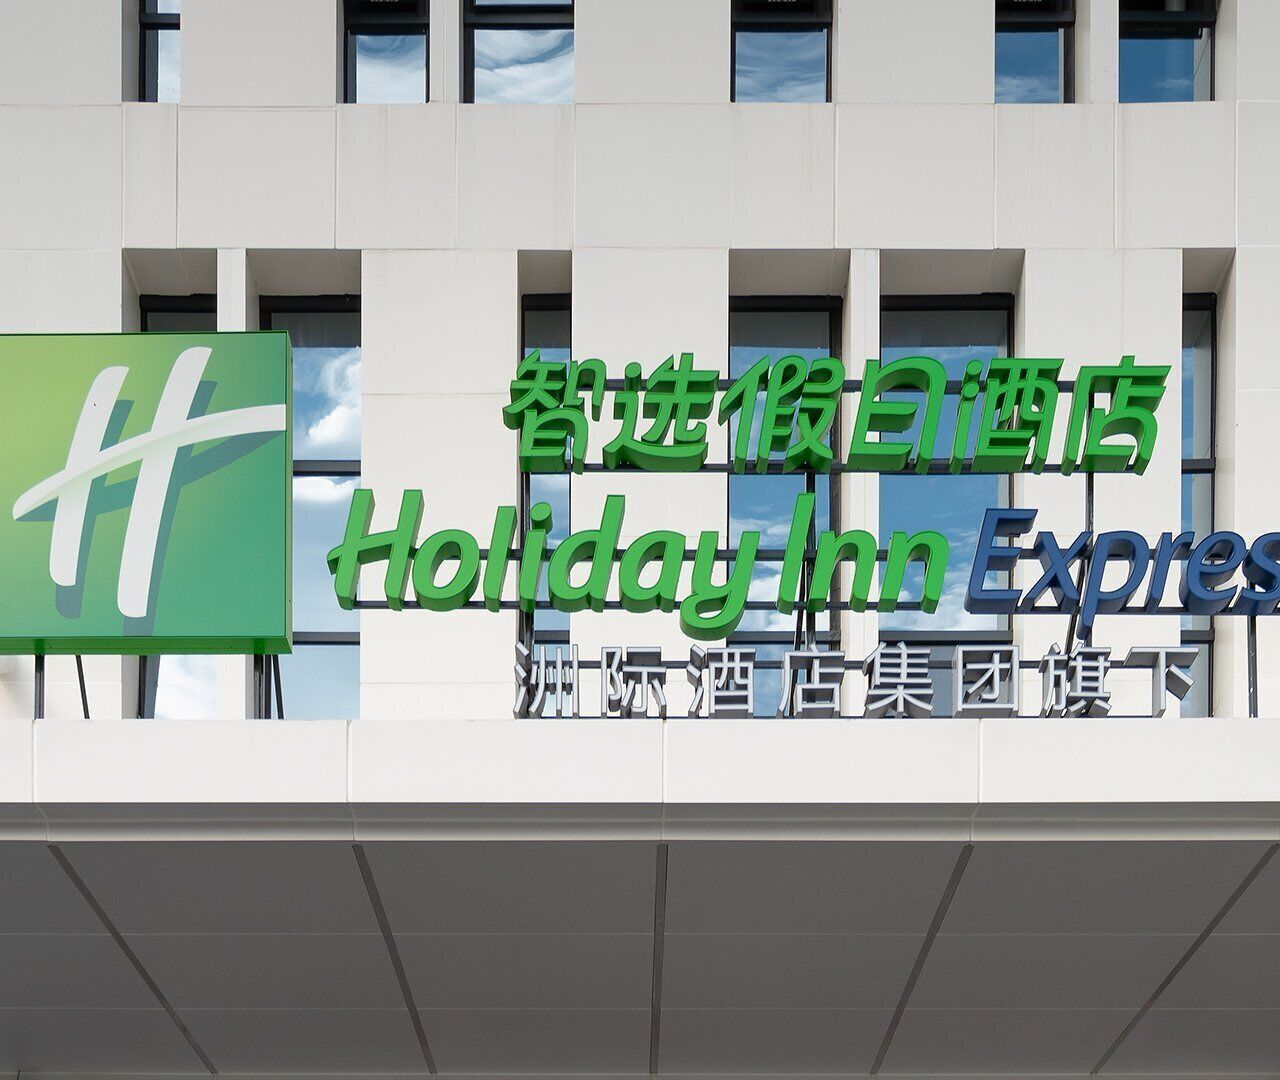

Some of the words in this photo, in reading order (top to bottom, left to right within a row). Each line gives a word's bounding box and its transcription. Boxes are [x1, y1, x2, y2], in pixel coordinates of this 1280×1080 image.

[502, 348, 1172, 476] 智选假日酒店
[326, 489, 761, 641] Holiday
[775, 493, 950, 615] Inn
[514, 642, 1199, 719] 洲际酒店集团旗下
